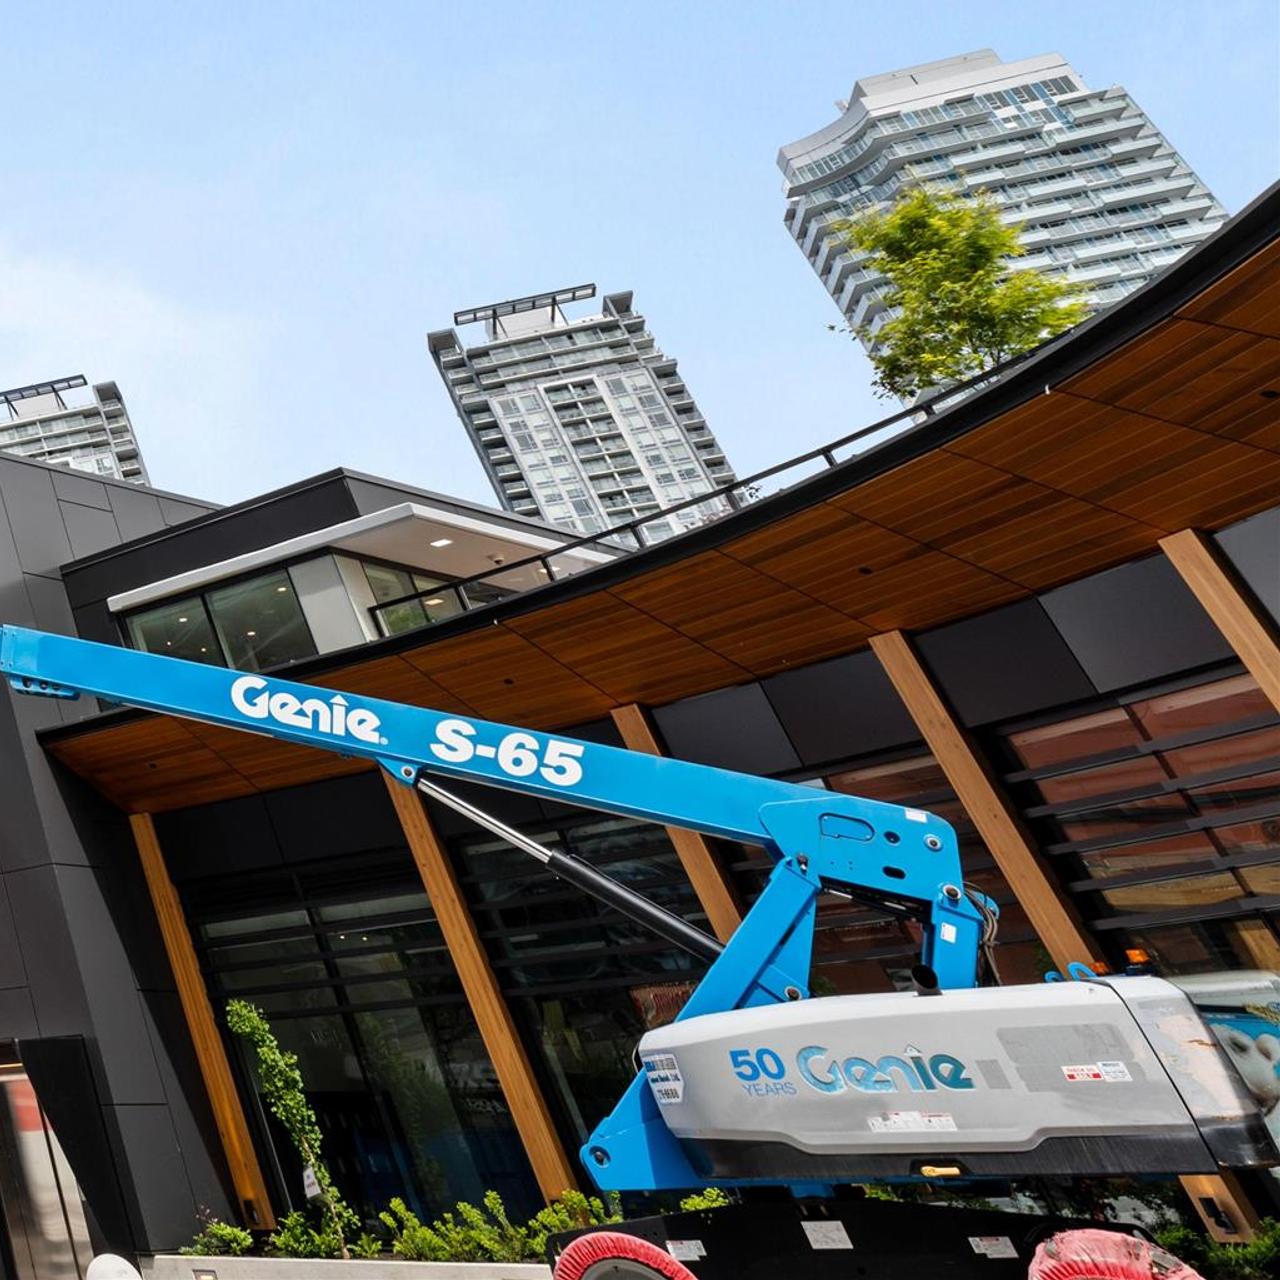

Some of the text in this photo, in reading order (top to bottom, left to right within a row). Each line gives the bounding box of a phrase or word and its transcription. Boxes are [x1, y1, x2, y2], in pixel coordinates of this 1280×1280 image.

[230, 675, 585, 787] Genie S-65
[729, 1047, 786, 1083] 50
[795, 1042, 977, 1095] Genie
[742, 1082, 798, 1097] YEARS
